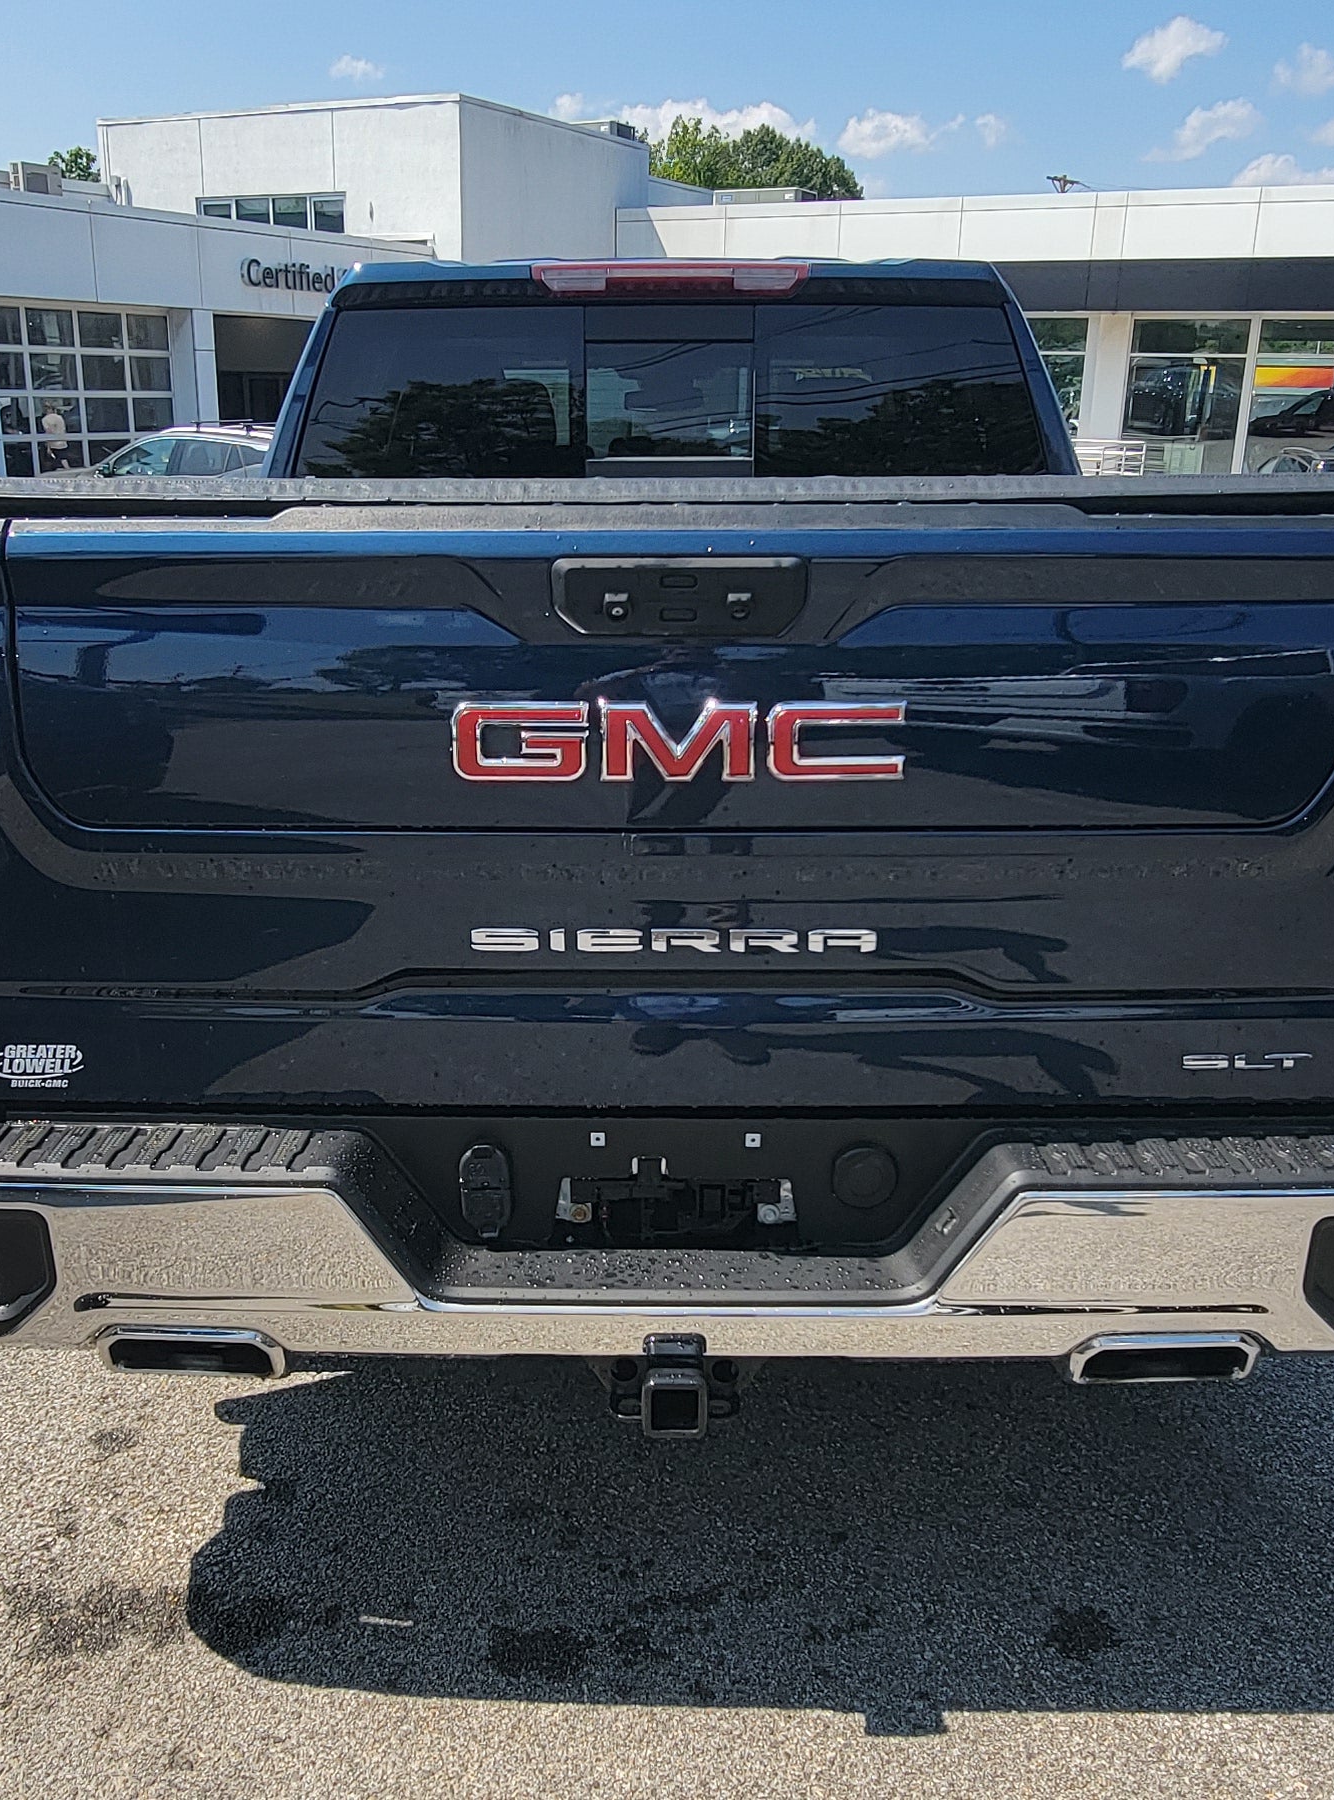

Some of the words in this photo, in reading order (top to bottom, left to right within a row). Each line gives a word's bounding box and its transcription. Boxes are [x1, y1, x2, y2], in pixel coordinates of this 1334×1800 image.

[247, 258, 335, 293] Certified
[450, 698, 908, 783] GMC
[470, 926, 879, 954] SIERRA
[4, 1044, 77, 1059] GREATER
[1181, 1052, 1313, 1070] SLT
[2, 1058, 73, 1074] LOWELL
